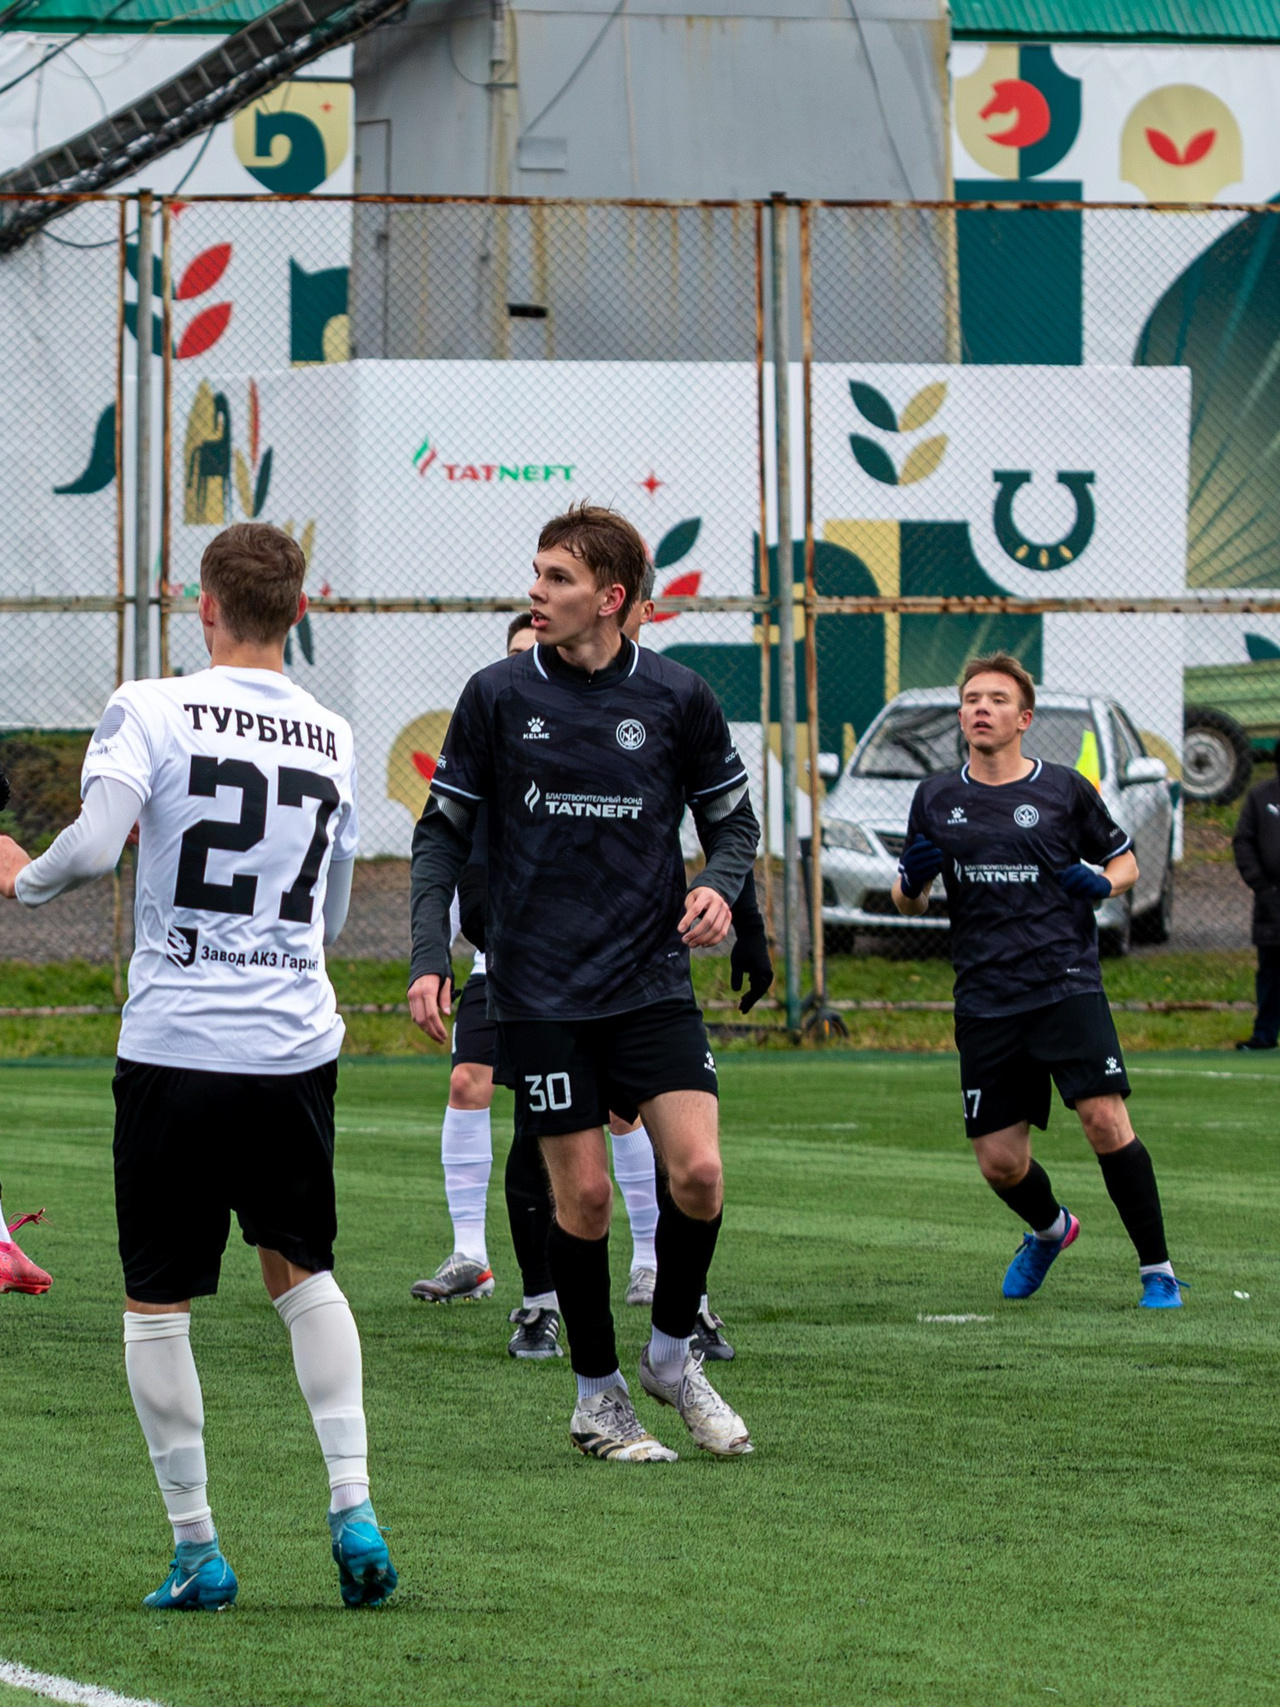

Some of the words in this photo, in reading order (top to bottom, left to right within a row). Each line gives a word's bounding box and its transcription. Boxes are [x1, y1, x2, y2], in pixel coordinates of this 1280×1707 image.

[443, 464, 575, 482] TATNEFT
[183, 703, 338, 762] ТУРБИНА
[523, 732, 550, 740] KELME
[545, 792, 621, 804] БЛАГОТВОРИТЕЛЬНЫЙ
[622, 797, 643, 806] ФОНД
[545, 801, 643, 820] TATNEFT
[173, 754, 341, 925] 27
[966, 871, 1040, 883] TATNEFT
[201, 945, 246, 967] Завод
[249, 950, 278, 967] АКЗ
[524, 1071, 572, 1112] 30
